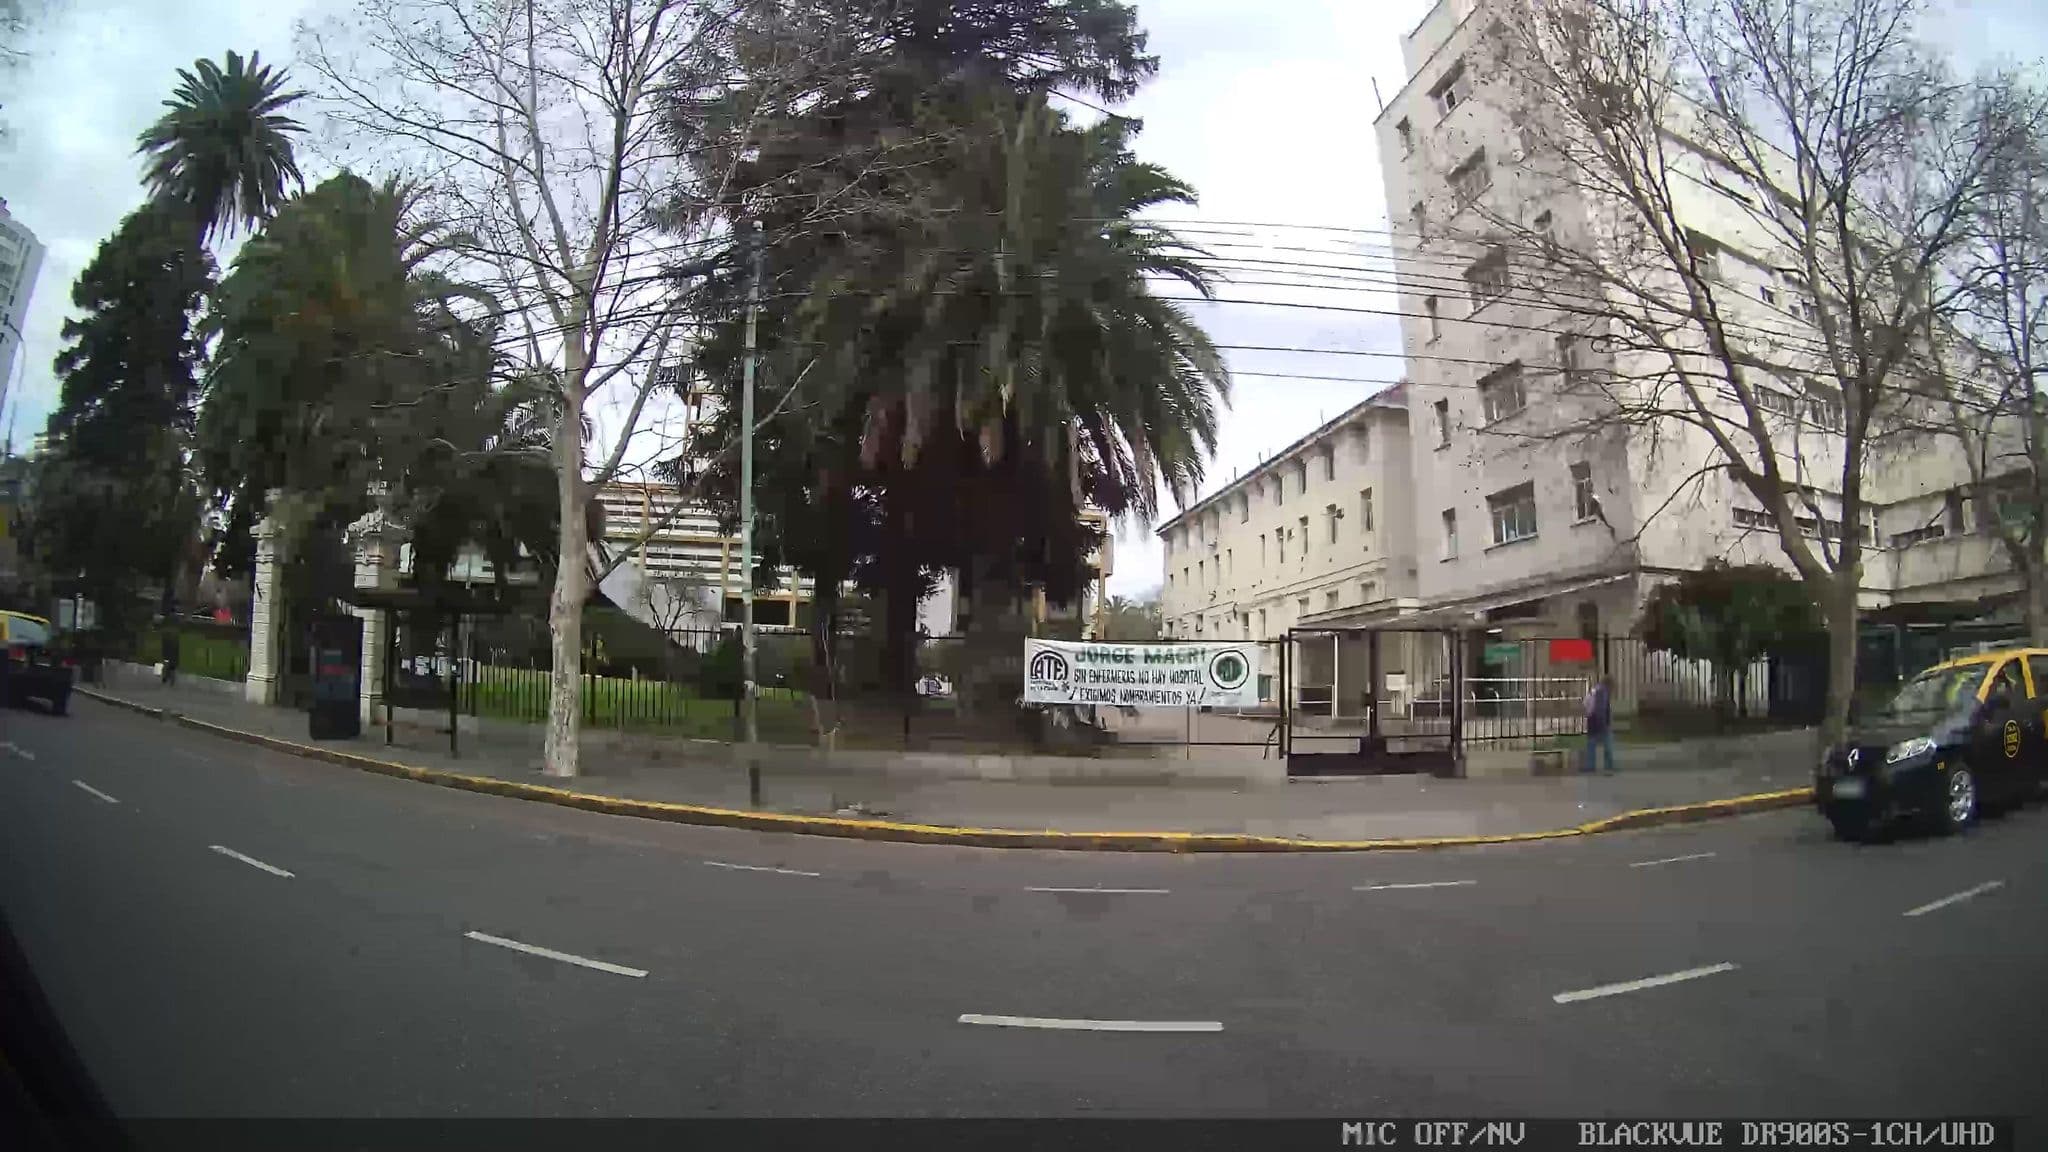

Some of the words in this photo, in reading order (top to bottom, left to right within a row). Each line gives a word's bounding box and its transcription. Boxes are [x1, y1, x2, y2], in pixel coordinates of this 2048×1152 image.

[1075, 646, 1135, 664] JORGE
[1031, 653, 1065, 680] ATE
[1074, 668, 1087, 683] SIN
[1089, 669, 1136, 684] ENFERMERAS
[1138, 670, 1149, 685] NO
[1151, 670, 1166, 684] HAY
[1169, 669, 1204, 685] HOSPITAL
